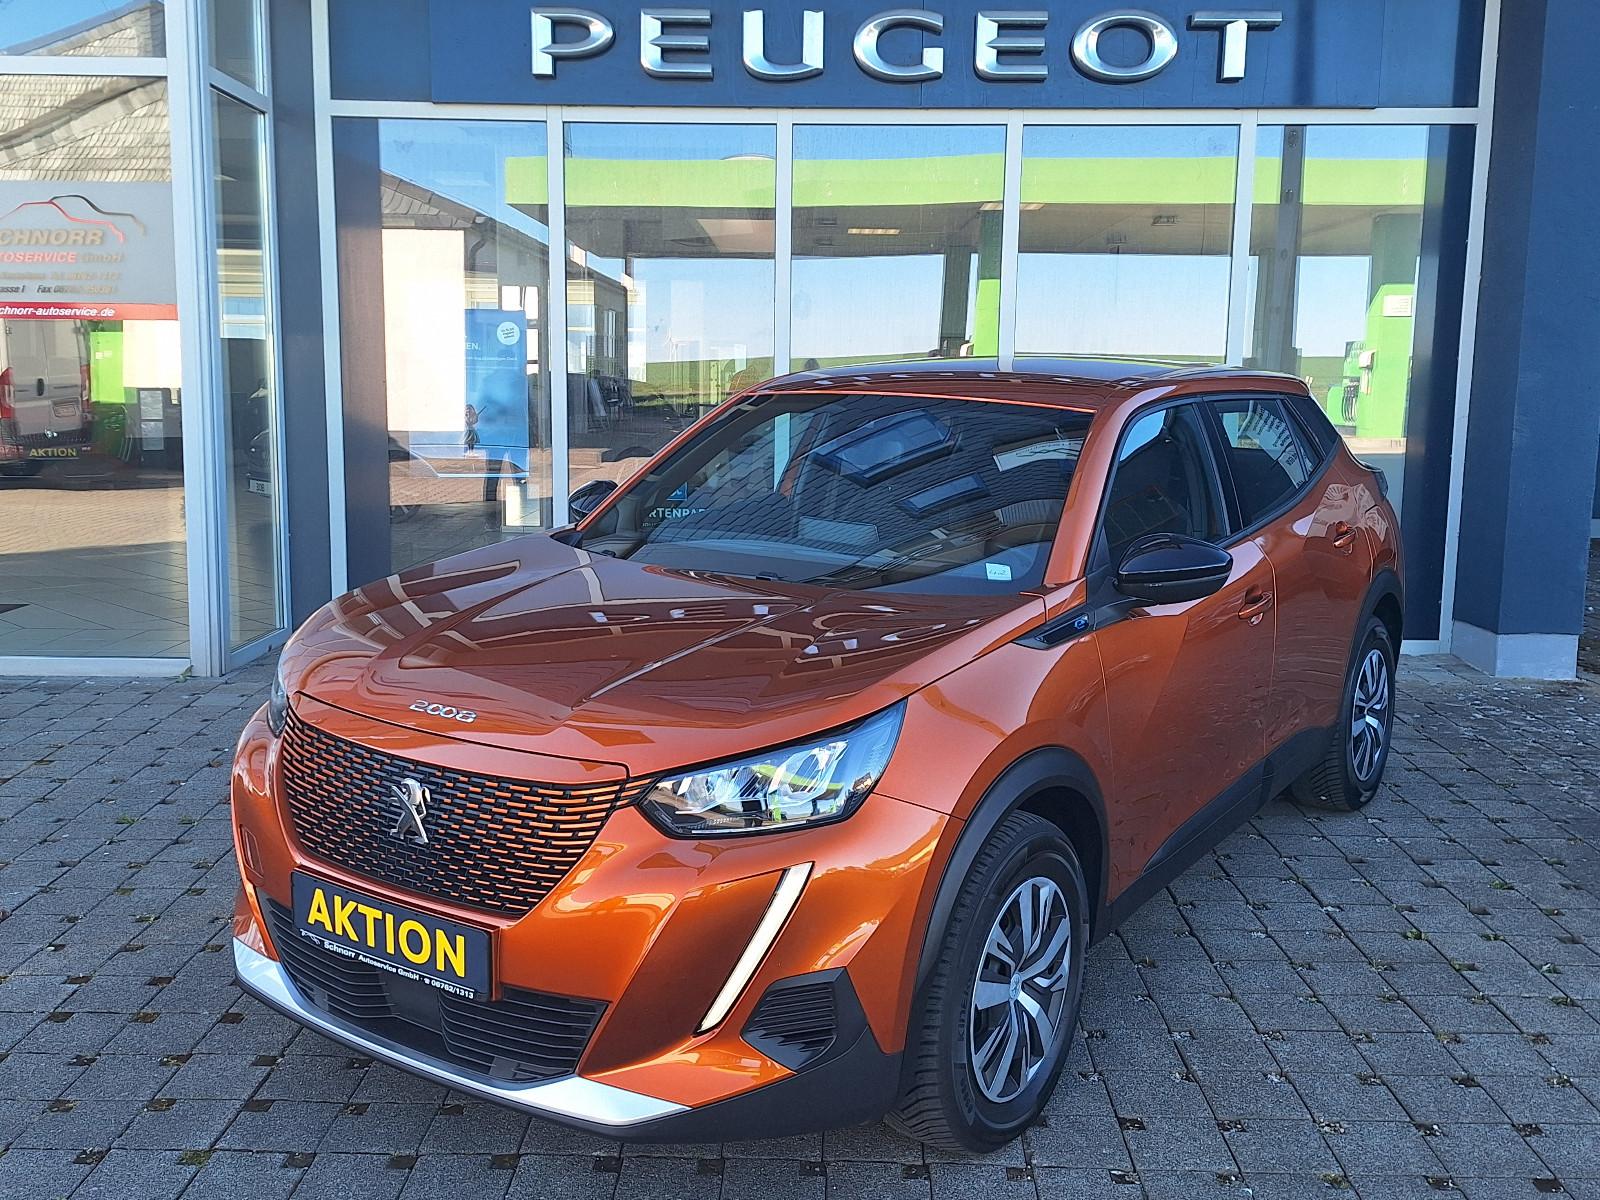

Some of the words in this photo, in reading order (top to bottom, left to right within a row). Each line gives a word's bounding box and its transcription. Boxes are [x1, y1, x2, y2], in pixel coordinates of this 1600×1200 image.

[531, 8, 1283, 81] PEUGEOT
[29, 447, 77, 457] AKTION
[409, 699, 477, 723] 2008
[307, 888, 466, 978] AKTION
[323, 941, 356, 958] Schnorr
[358, 955, 397, 973] Autoservice
[398, 968, 420, 981] GmbH
